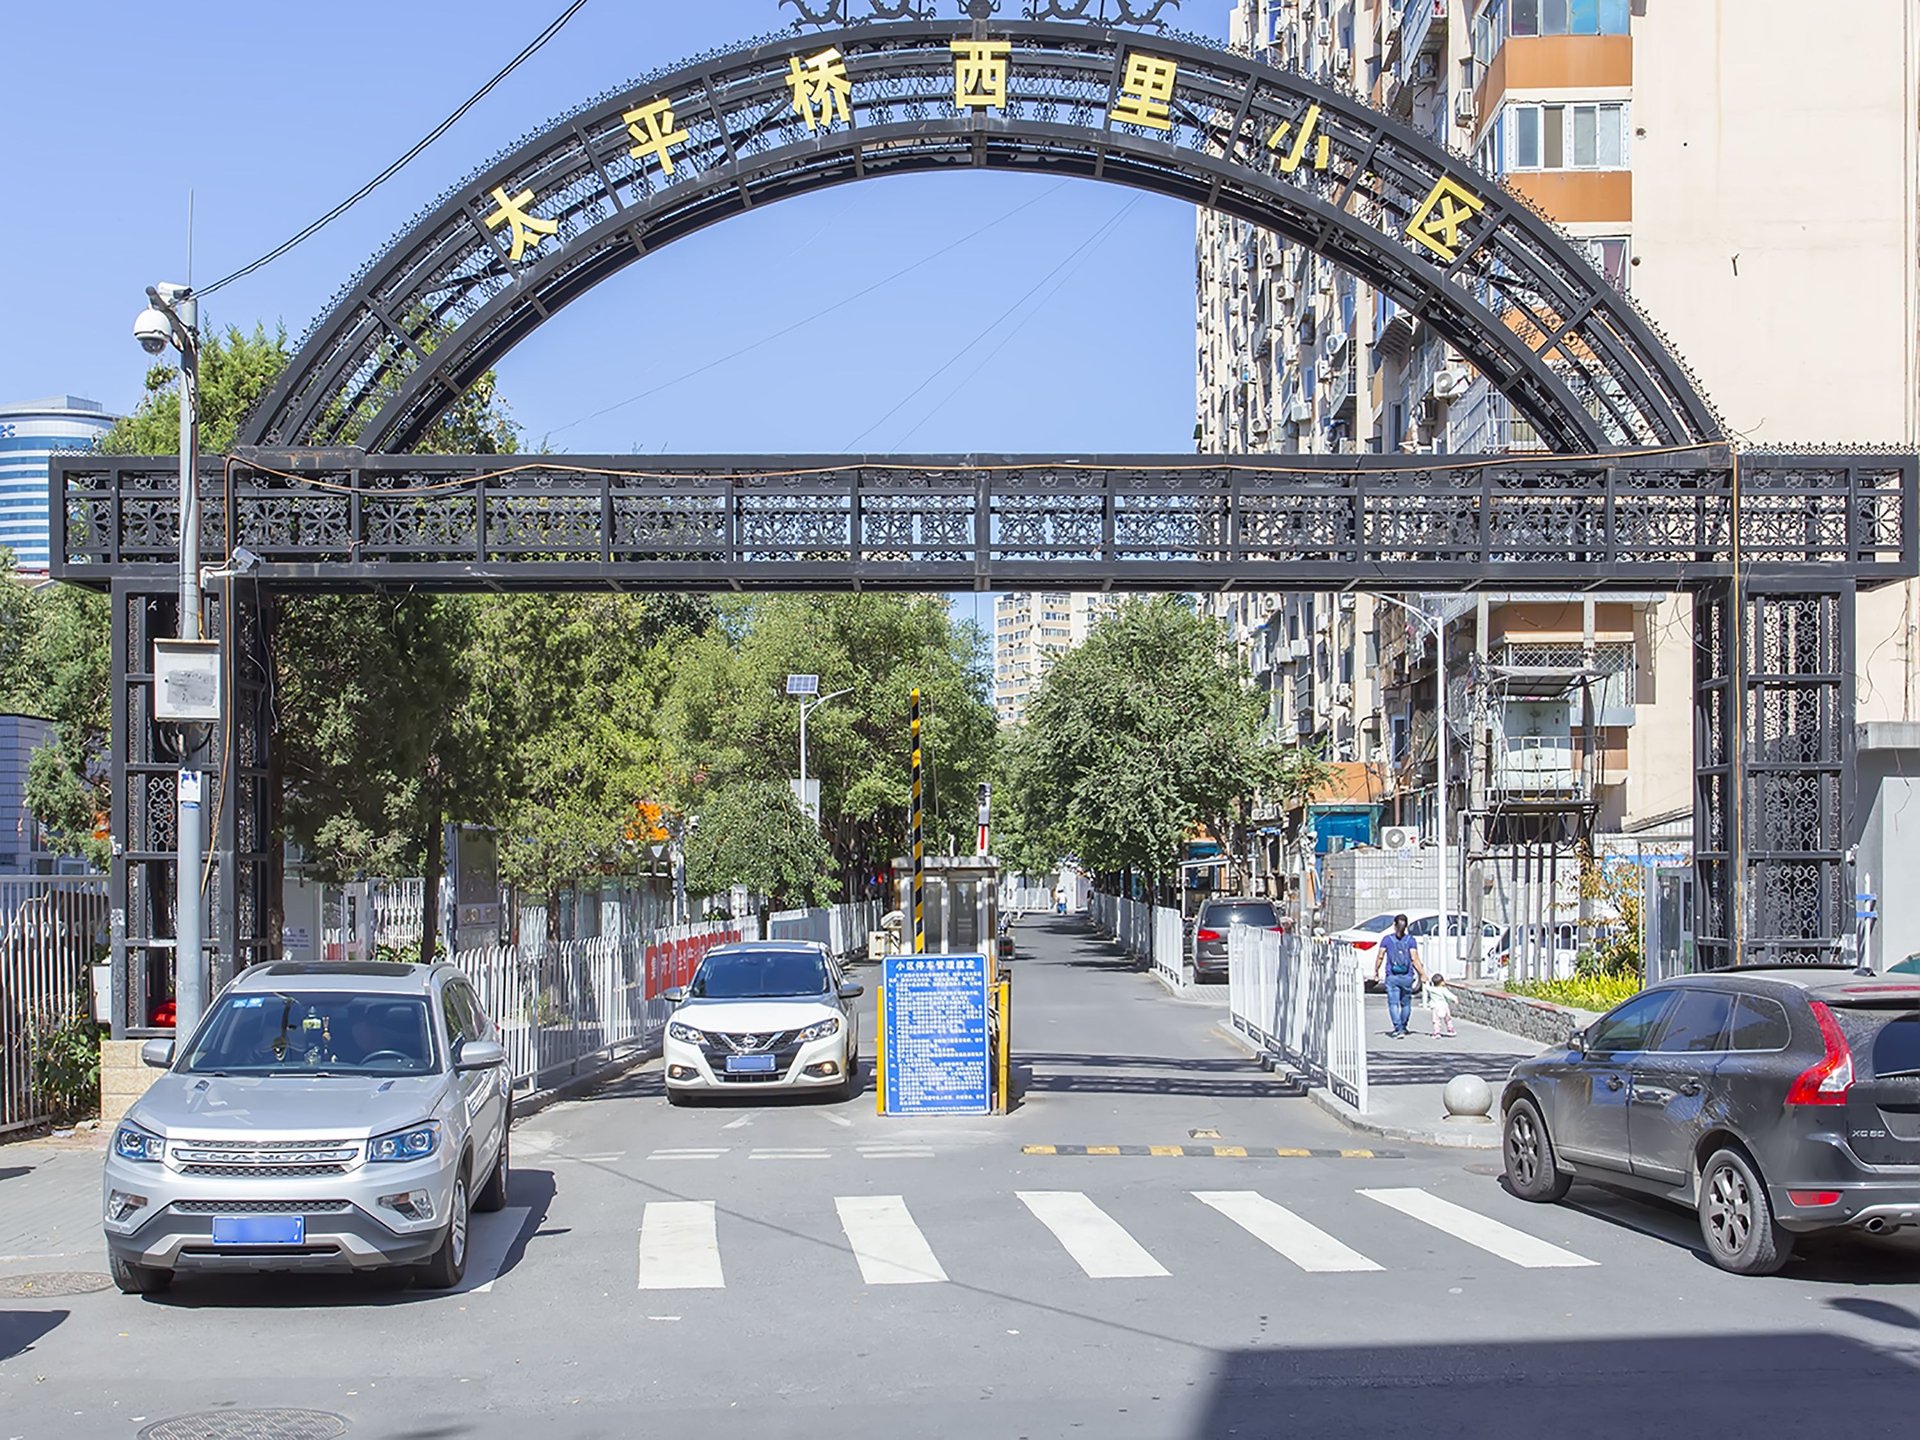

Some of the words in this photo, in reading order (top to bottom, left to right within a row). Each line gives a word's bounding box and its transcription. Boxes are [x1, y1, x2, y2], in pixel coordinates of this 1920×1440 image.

[485, 40, 1485, 262] 太平桥西里小区
[1852, 1130, 1886, 1138] XC60
[190, 1152, 338, 1161] CHANGAN
